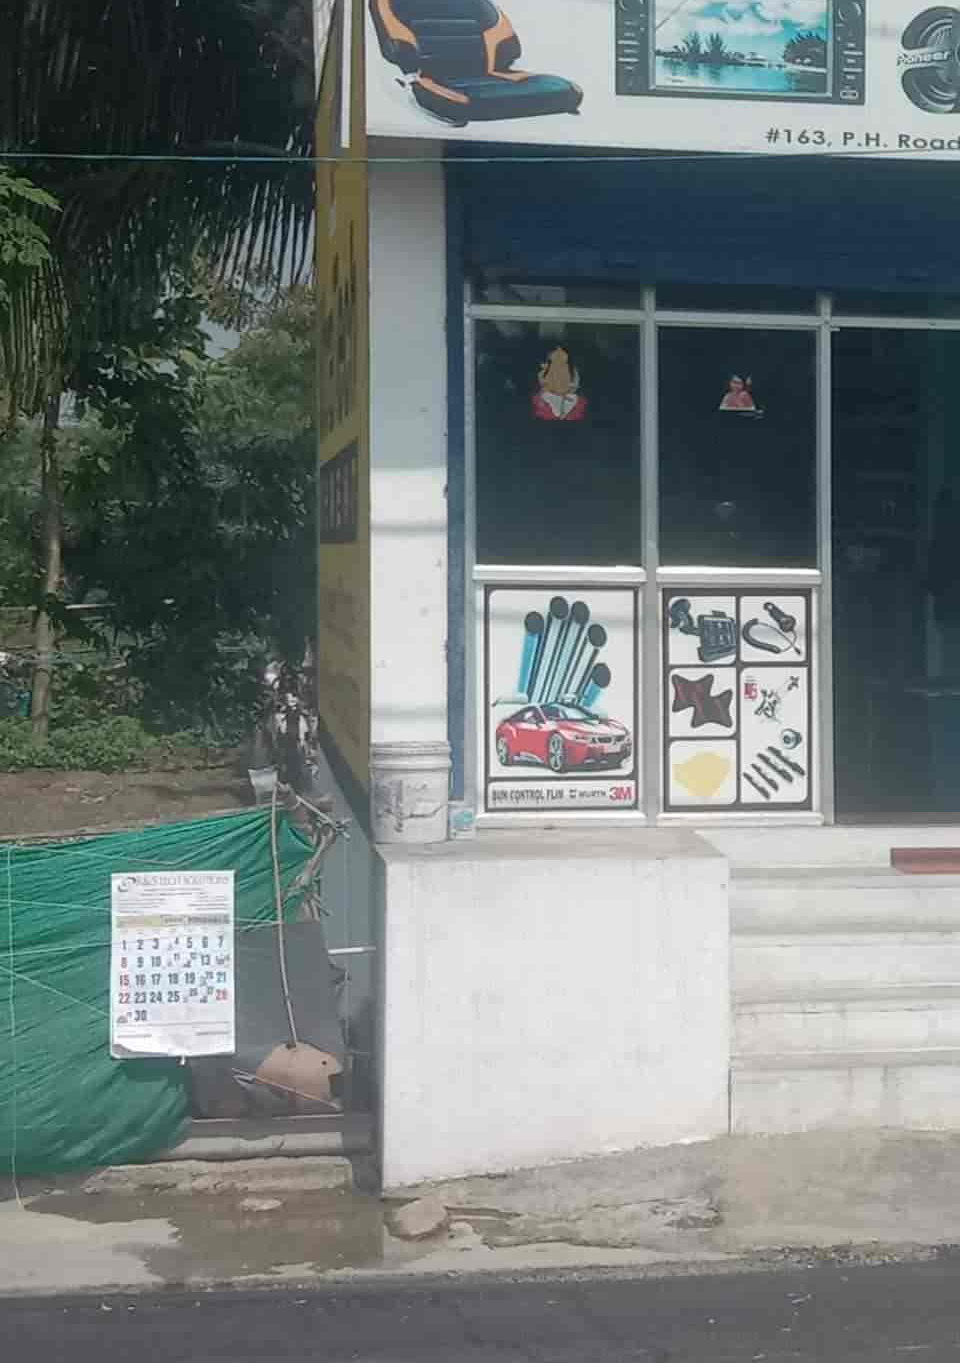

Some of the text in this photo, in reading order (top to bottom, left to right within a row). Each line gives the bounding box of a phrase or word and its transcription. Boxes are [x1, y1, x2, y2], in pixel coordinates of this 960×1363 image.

[766, 128, 833, 148] #163,
[842, 131, 889, 149] P.H.
[609, 785, 632, 801] 3M
